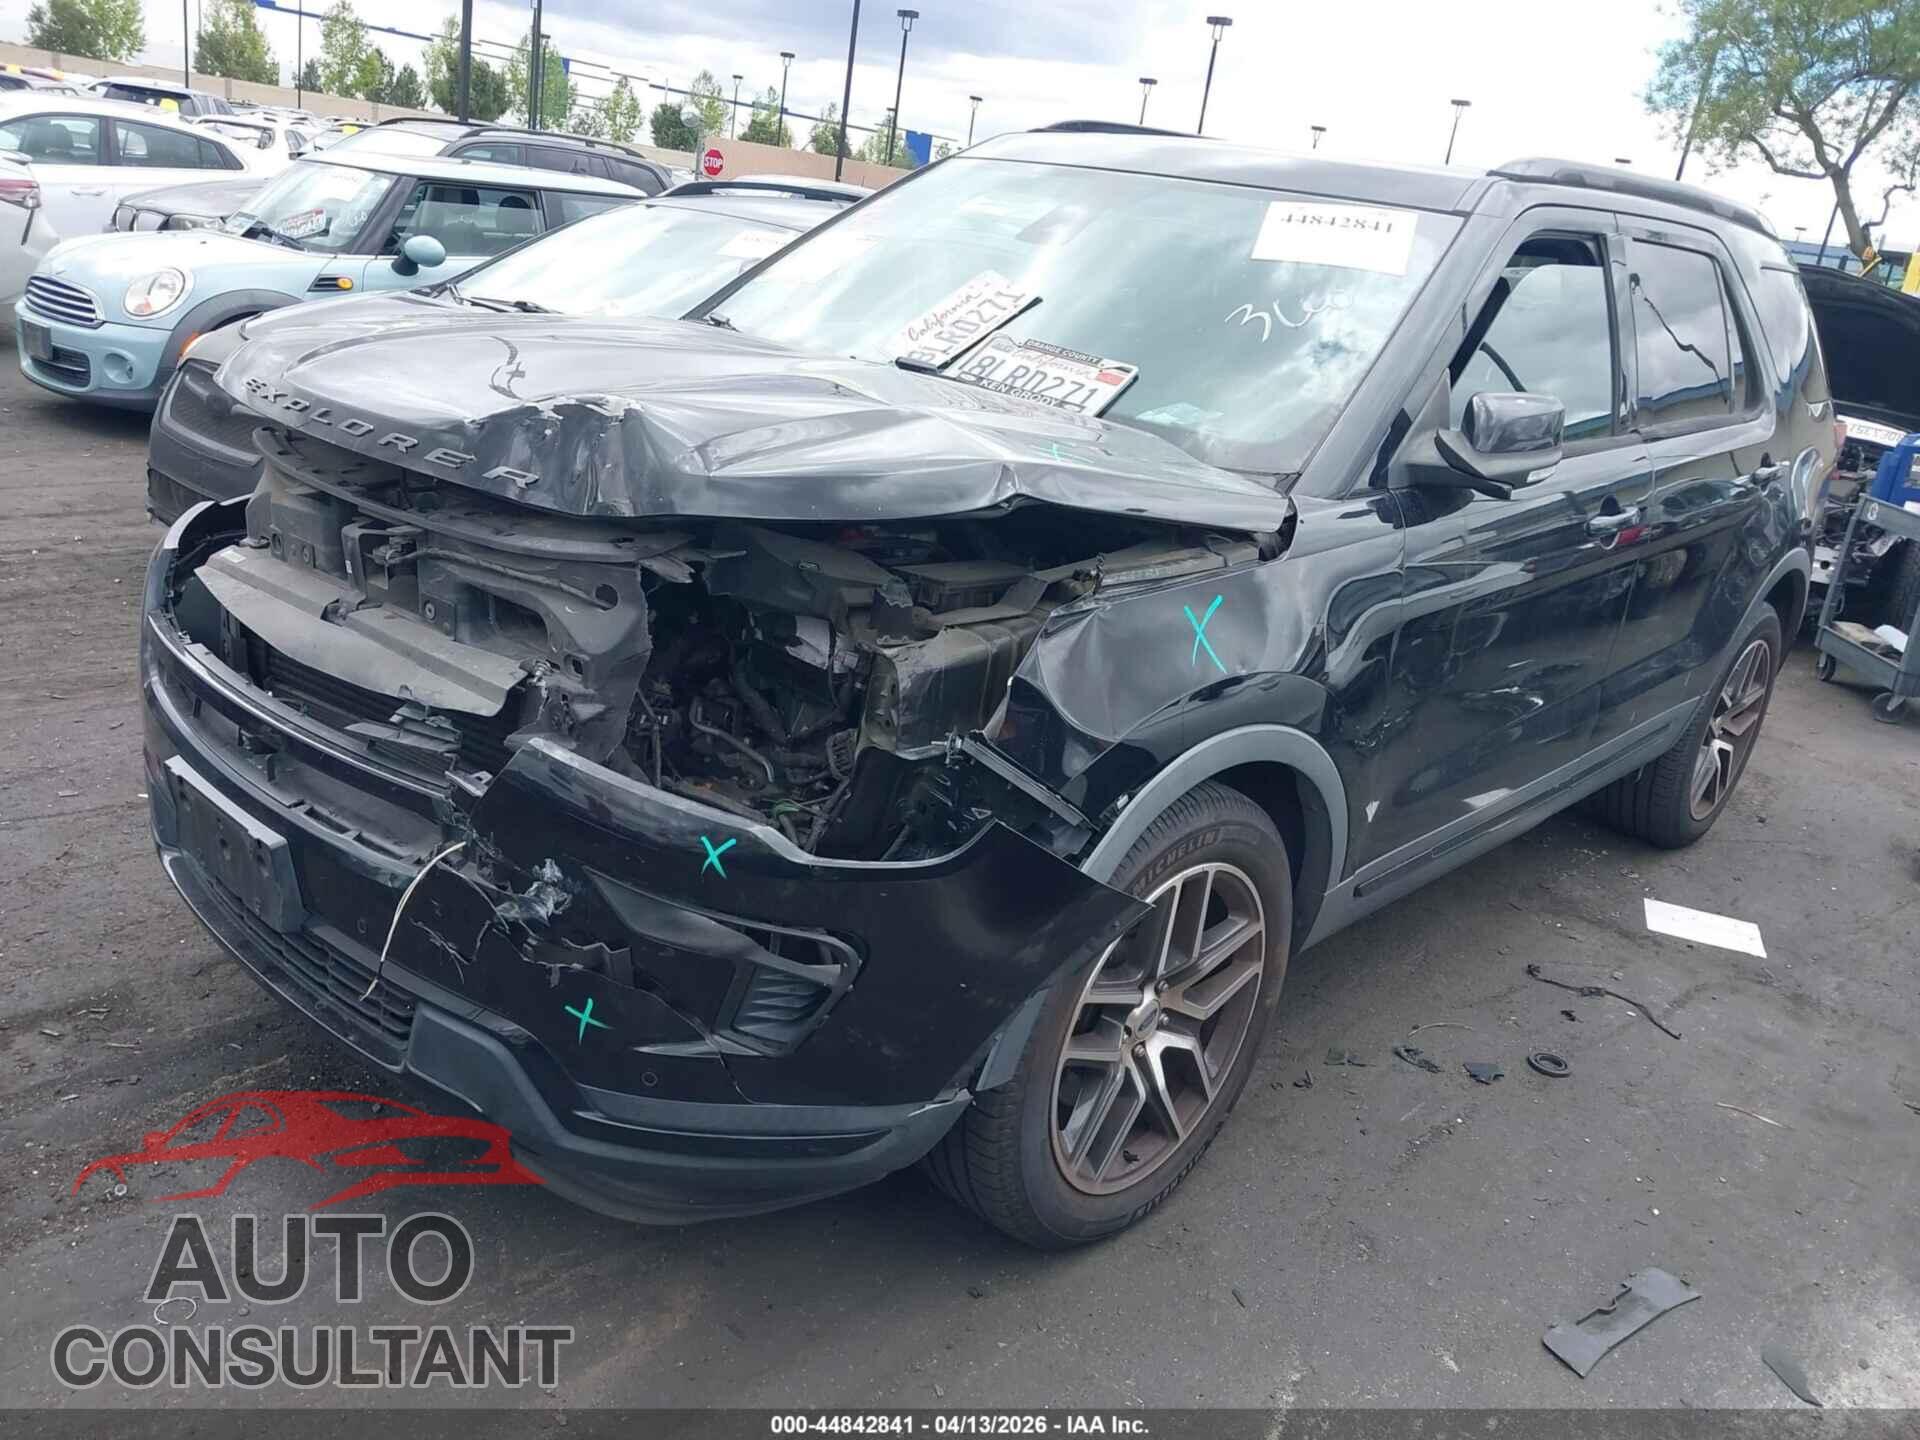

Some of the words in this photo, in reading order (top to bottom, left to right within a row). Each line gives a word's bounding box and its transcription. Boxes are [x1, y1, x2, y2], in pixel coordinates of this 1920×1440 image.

[704, 156, 723, 169] STOP
[1280, 212, 1394, 234] 44842841
[908, 290, 984, 342] California
[1025, 339, 1063, 354] ORANGE
[1063, 349, 1100, 365] COUNTY
[968, 355, 1099, 405] 8LRD271
[979, 378, 1010, 394] KEN
[1010, 385, 1062, 408] GRODY
[244, 376, 541, 490] EXPLORER
[1132, 829, 1217, 898] MICHELIN
